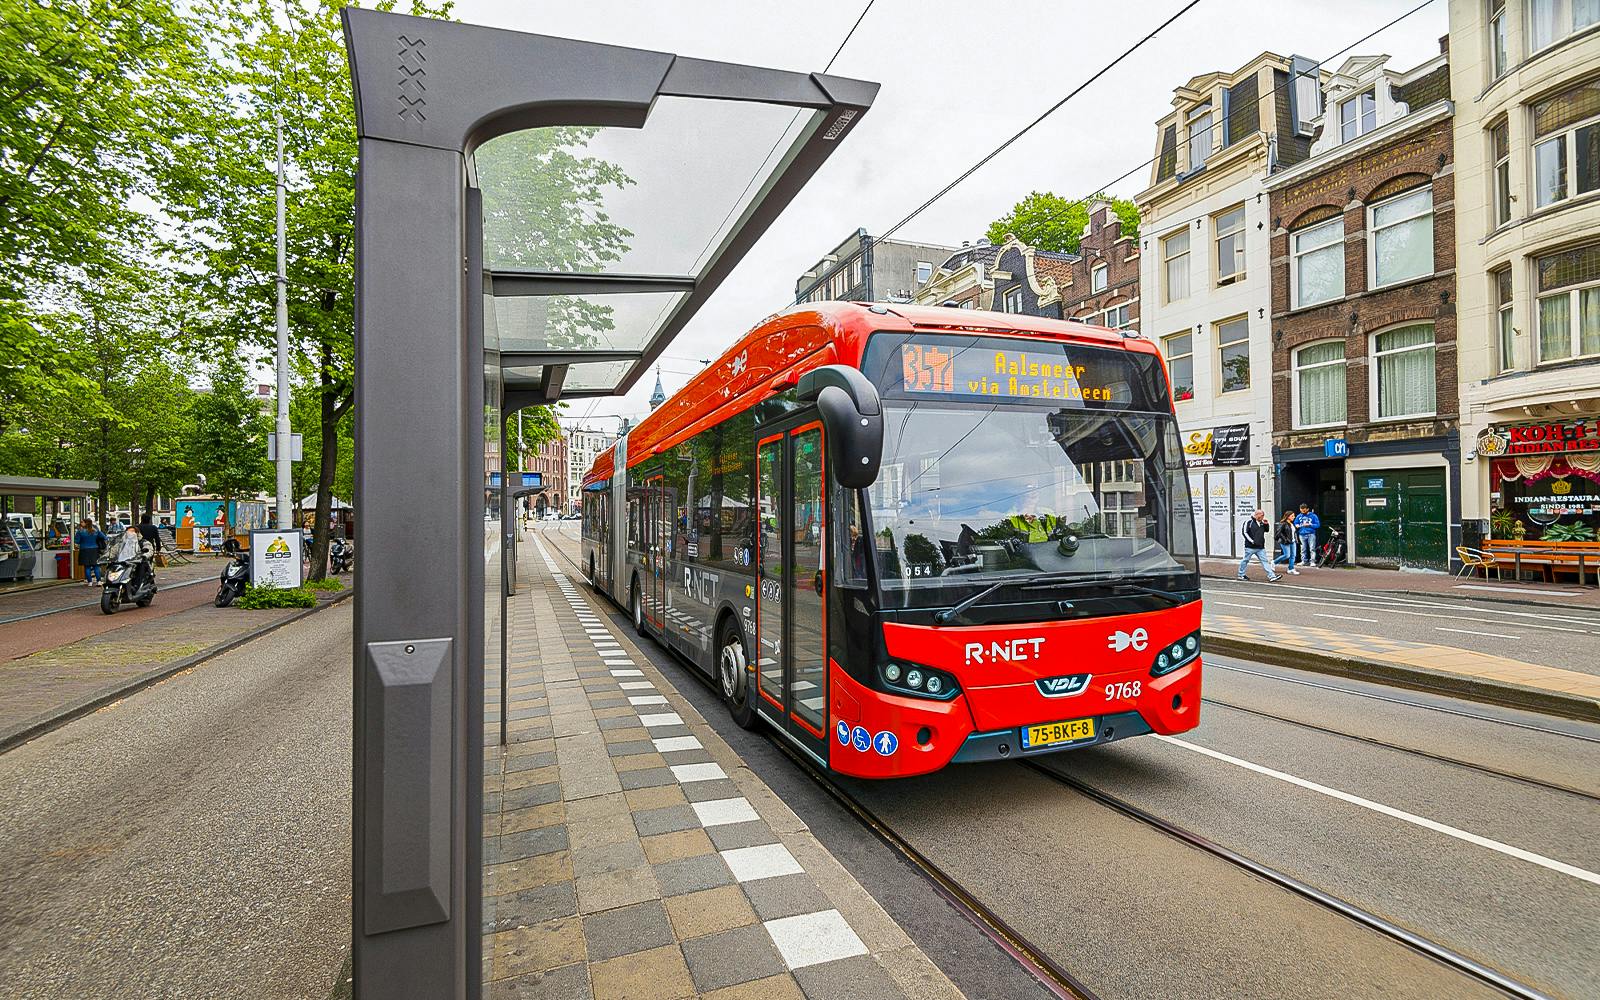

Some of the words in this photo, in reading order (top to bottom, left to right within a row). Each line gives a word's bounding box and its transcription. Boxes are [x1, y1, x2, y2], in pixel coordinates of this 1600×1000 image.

[995, 352, 1086, 379] Aalsmeer
[968, 377, 999, 393] via
[1009, 377, 1112, 400] Amstelveen
[1509, 422, 1600, 442] KOH-I-
[1510, 441, 1564, 453] INDIAN
[1568, 439, 1600, 450] RES
[905, 566, 931, 576] 054
[744, 618, 756, 635] 9768
[1044, 677, 1082, 692] VDL
[1105, 681, 1141, 701] 9768
[1033, 722, 1089, 743] 75-BKF-8
